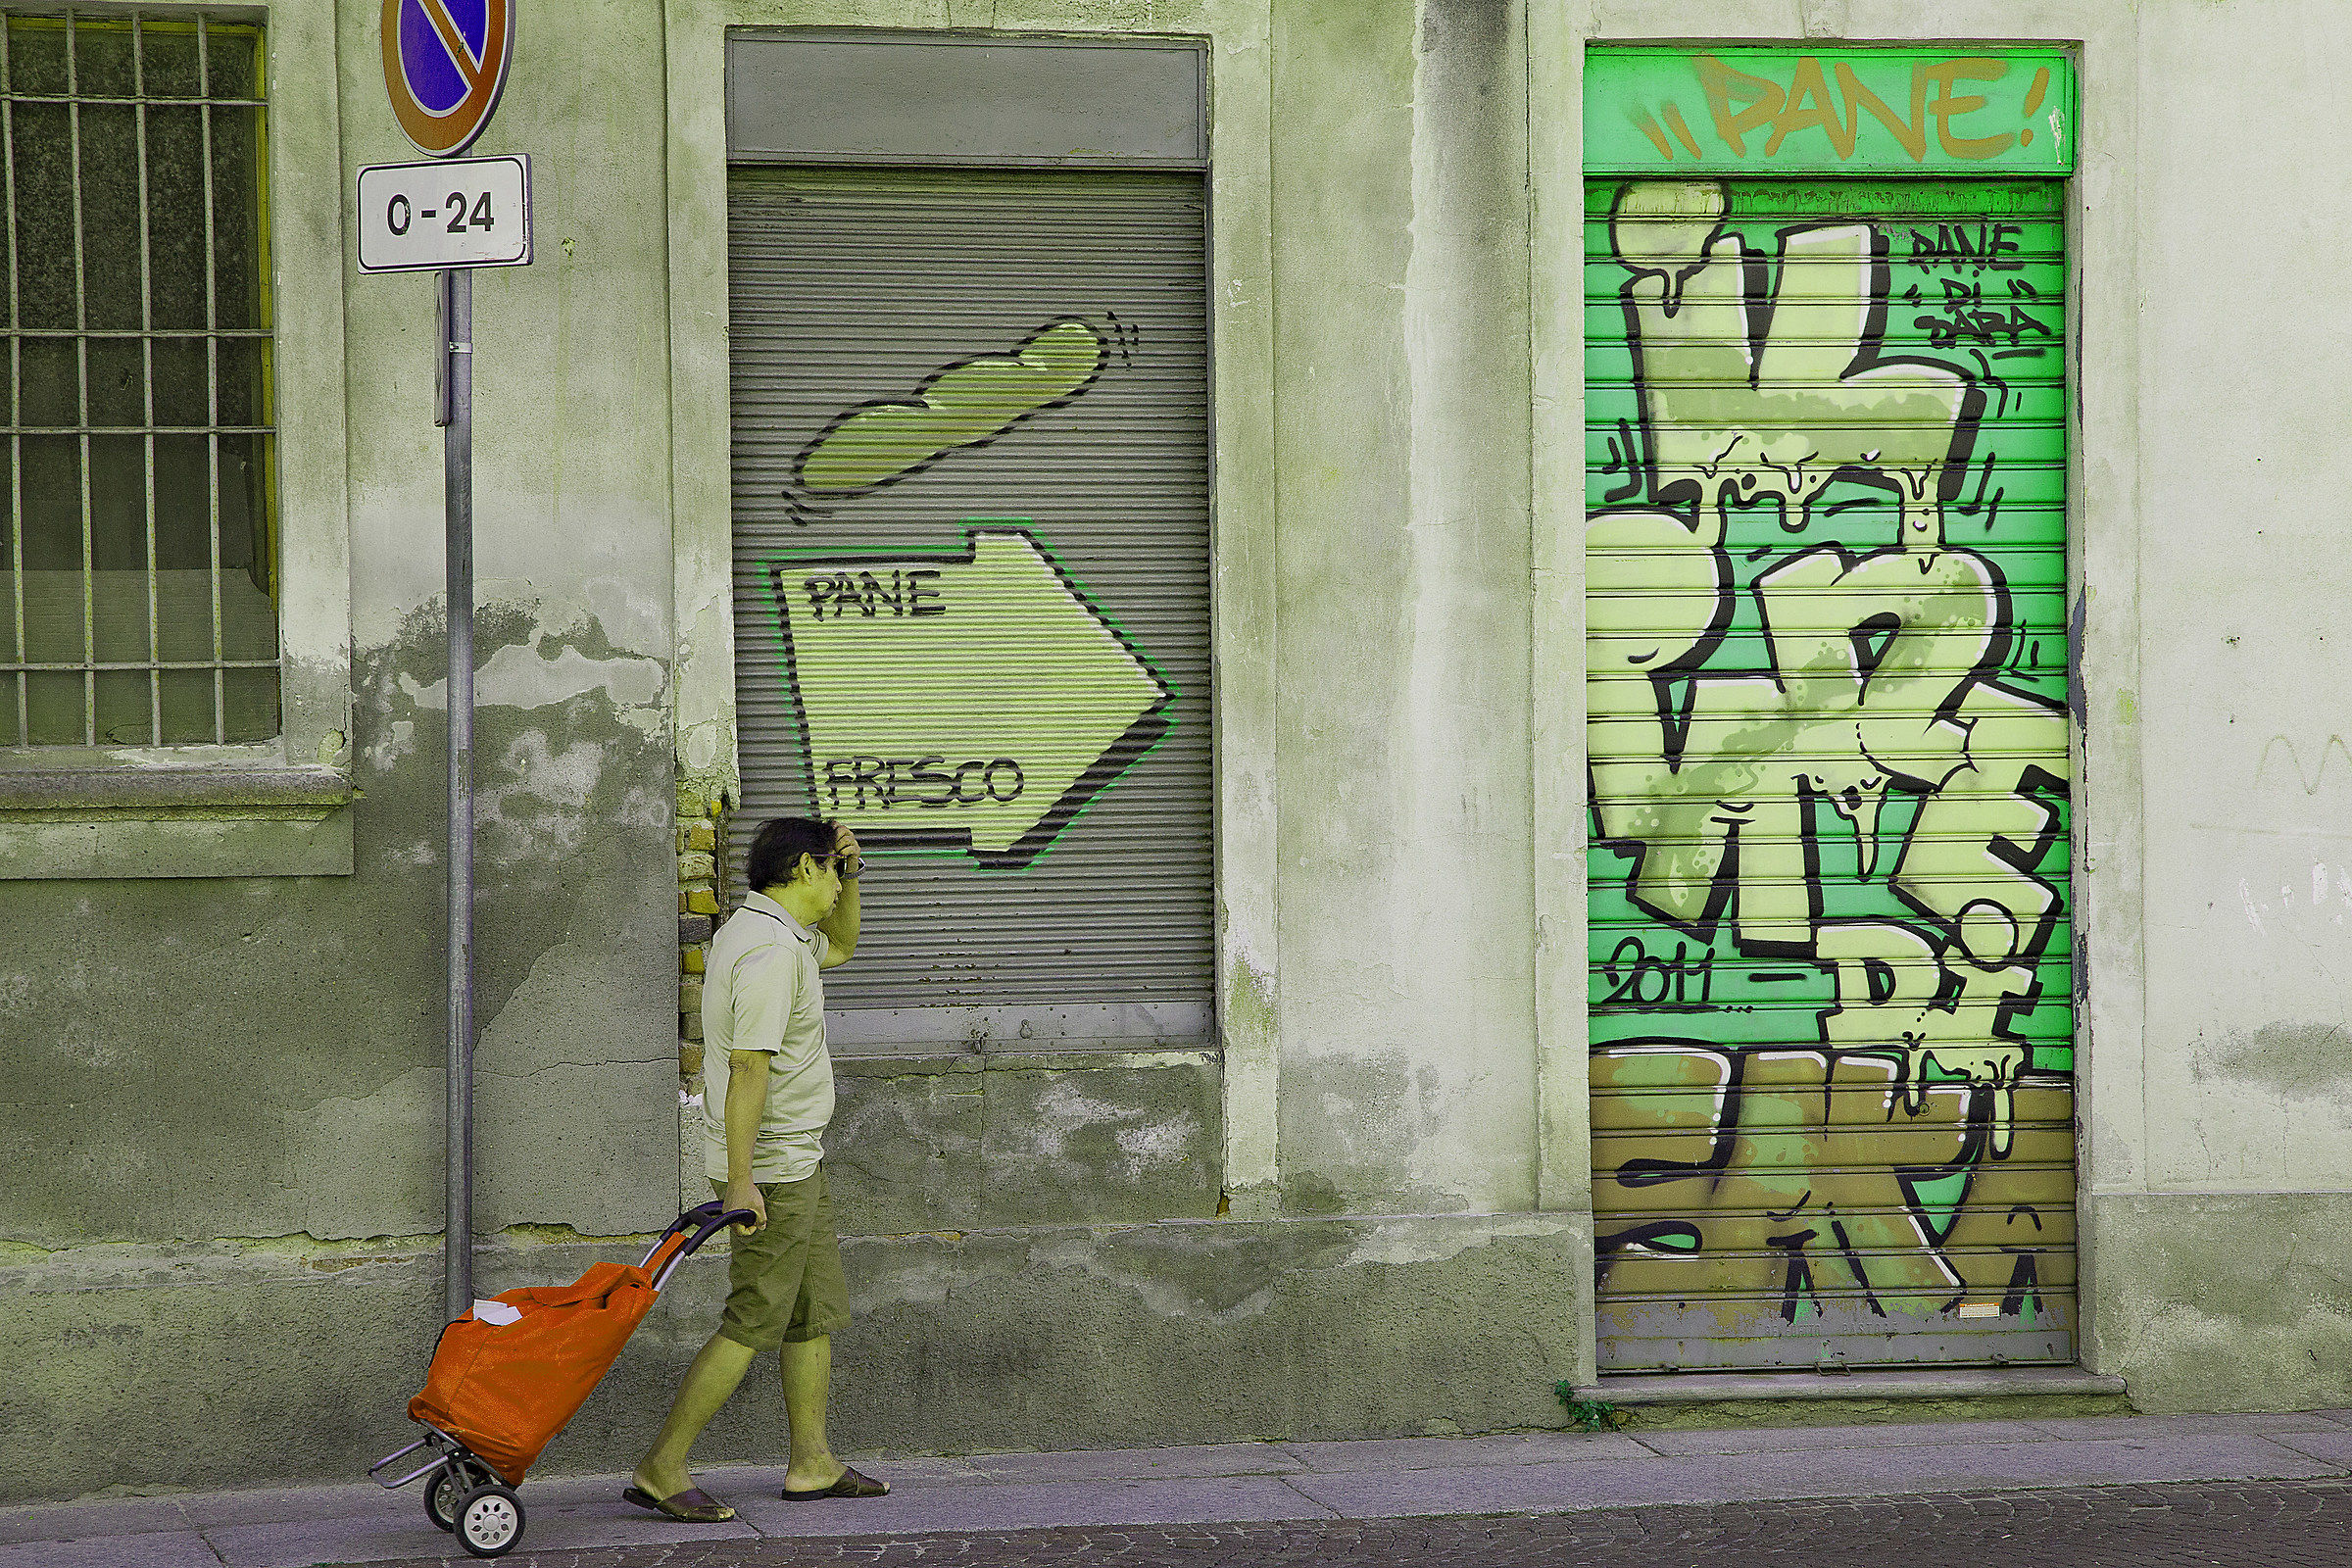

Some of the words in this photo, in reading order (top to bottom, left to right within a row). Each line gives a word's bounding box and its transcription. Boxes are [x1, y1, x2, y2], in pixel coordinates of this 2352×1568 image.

[1910, 223, 2026, 275] PANE
[804, 569, 947, 622] PANE
[824, 755, 1025, 809] FRESCO
[1601, 936, 1716, 1004] 2011
